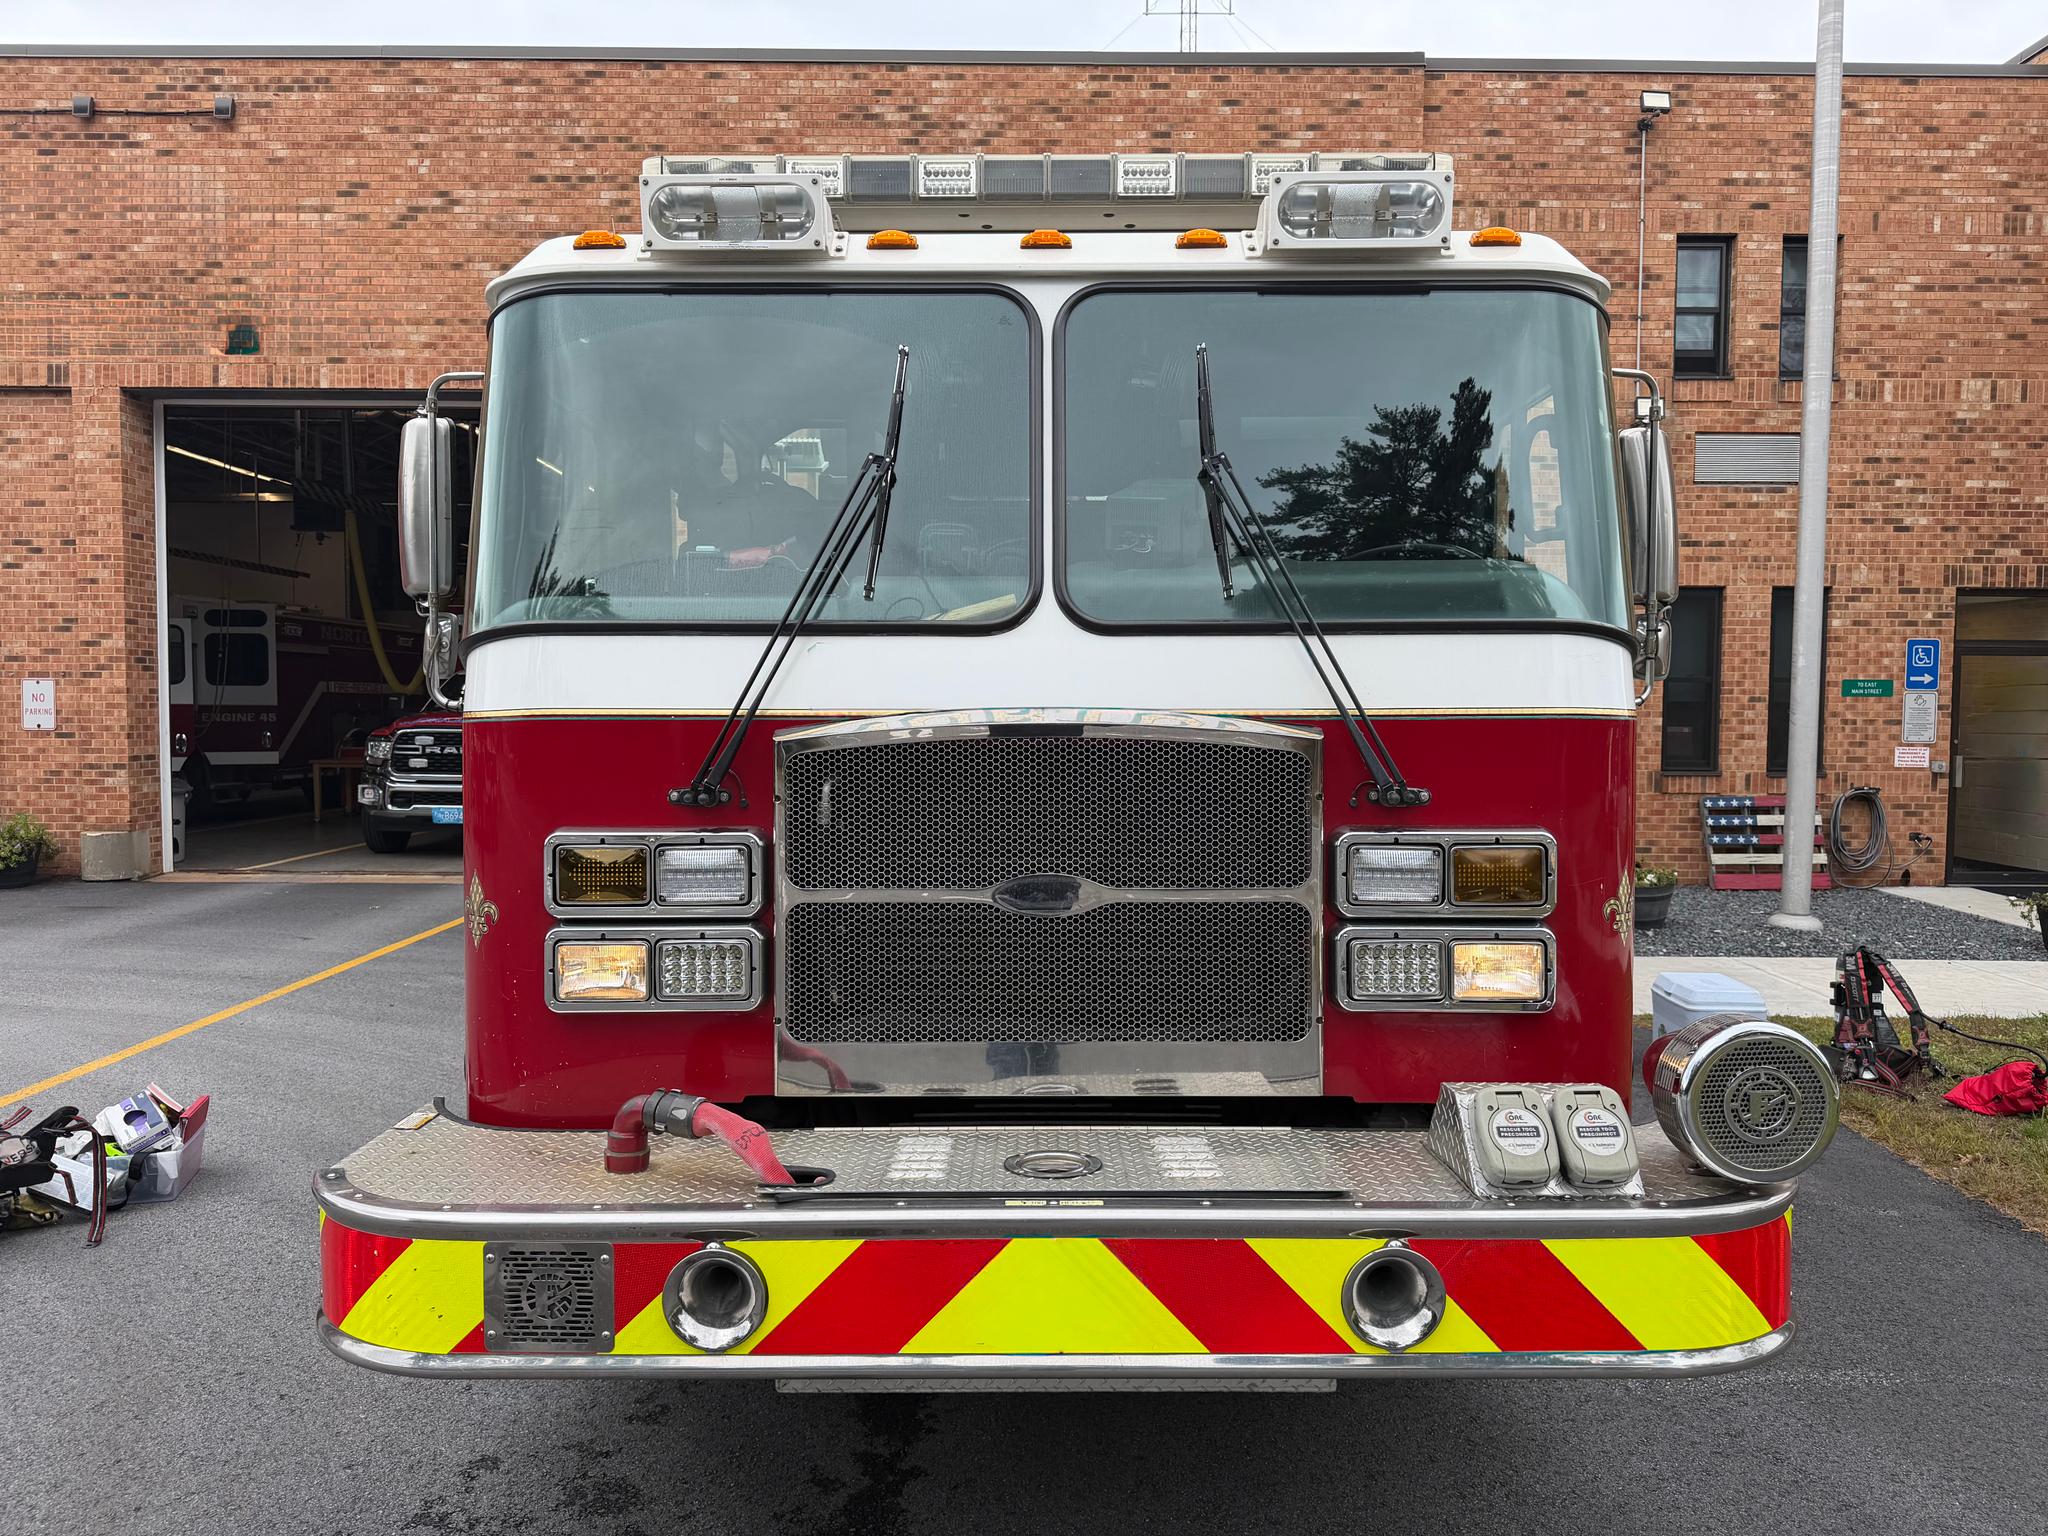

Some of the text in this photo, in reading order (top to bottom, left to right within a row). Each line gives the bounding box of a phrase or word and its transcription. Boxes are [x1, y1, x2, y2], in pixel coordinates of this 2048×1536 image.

[31, 692, 45, 703] NO
[24, 707, 53, 716] PARKING
[201, 712, 256, 722] ENGINE
[424, 746, 463, 754] RA
[1845, 956, 1856, 970] 3M
